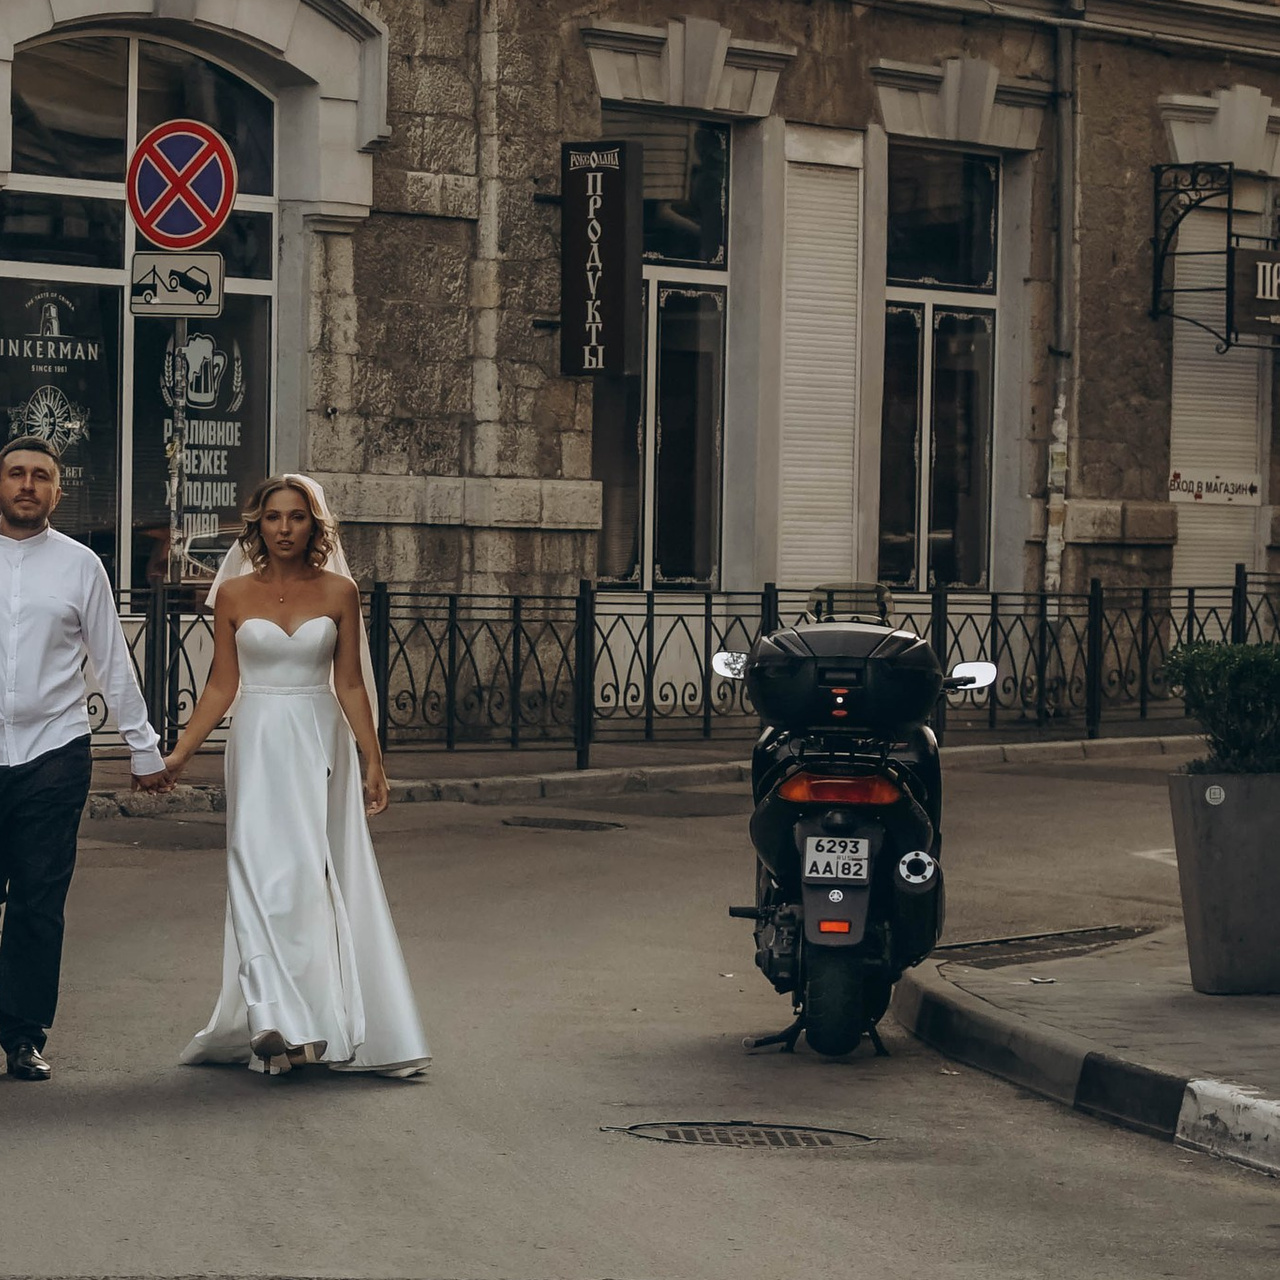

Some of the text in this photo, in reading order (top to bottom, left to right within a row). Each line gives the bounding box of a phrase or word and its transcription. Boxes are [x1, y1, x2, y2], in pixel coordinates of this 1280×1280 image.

[583, 172, 605, 369] ПРОДУКТЫ
[0, 339, 99, 361] INKERMAN
[31, 365, 52, 373] SINCE
[163, 419, 242, 447] РЗЛИВНОЕ
[183, 449, 228, 475] ВЕЖЕЕ
[1169, 480, 1195, 494] ВХОД
[1205, 482, 1248, 495] МАГАЗИН
[815, 839, 860, 854] 6293
[841, 862, 863, 877] 82
